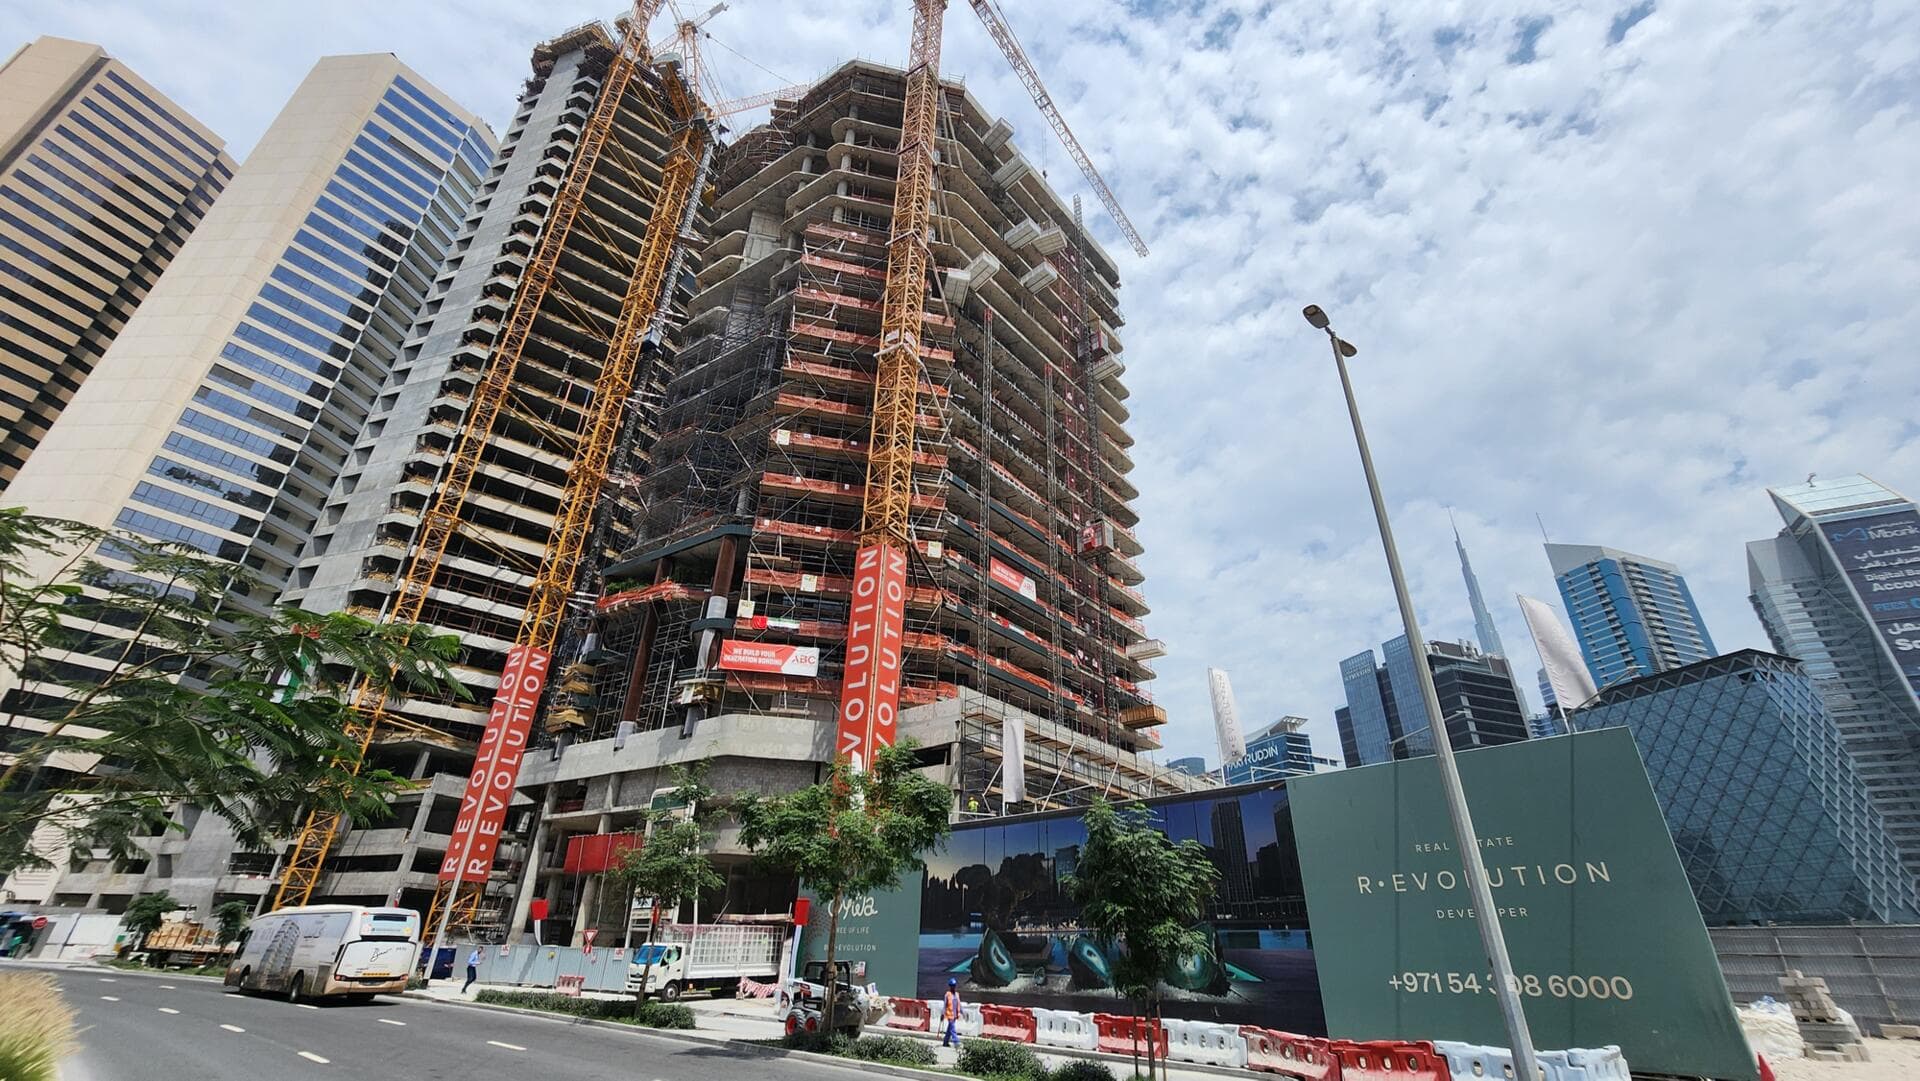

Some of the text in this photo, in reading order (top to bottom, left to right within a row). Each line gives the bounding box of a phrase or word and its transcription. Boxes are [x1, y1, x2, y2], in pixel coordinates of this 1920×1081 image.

[843, 549, 878, 755] VOLUTION
[1415, 836, 1514, 853] REAL TATE
[1436, 907, 1529, 919] DEVEPER
[1389, 972, 1443, 994] +971
[1447, 972, 1482, 994] 54
[1548, 975, 1633, 1000] 6000
